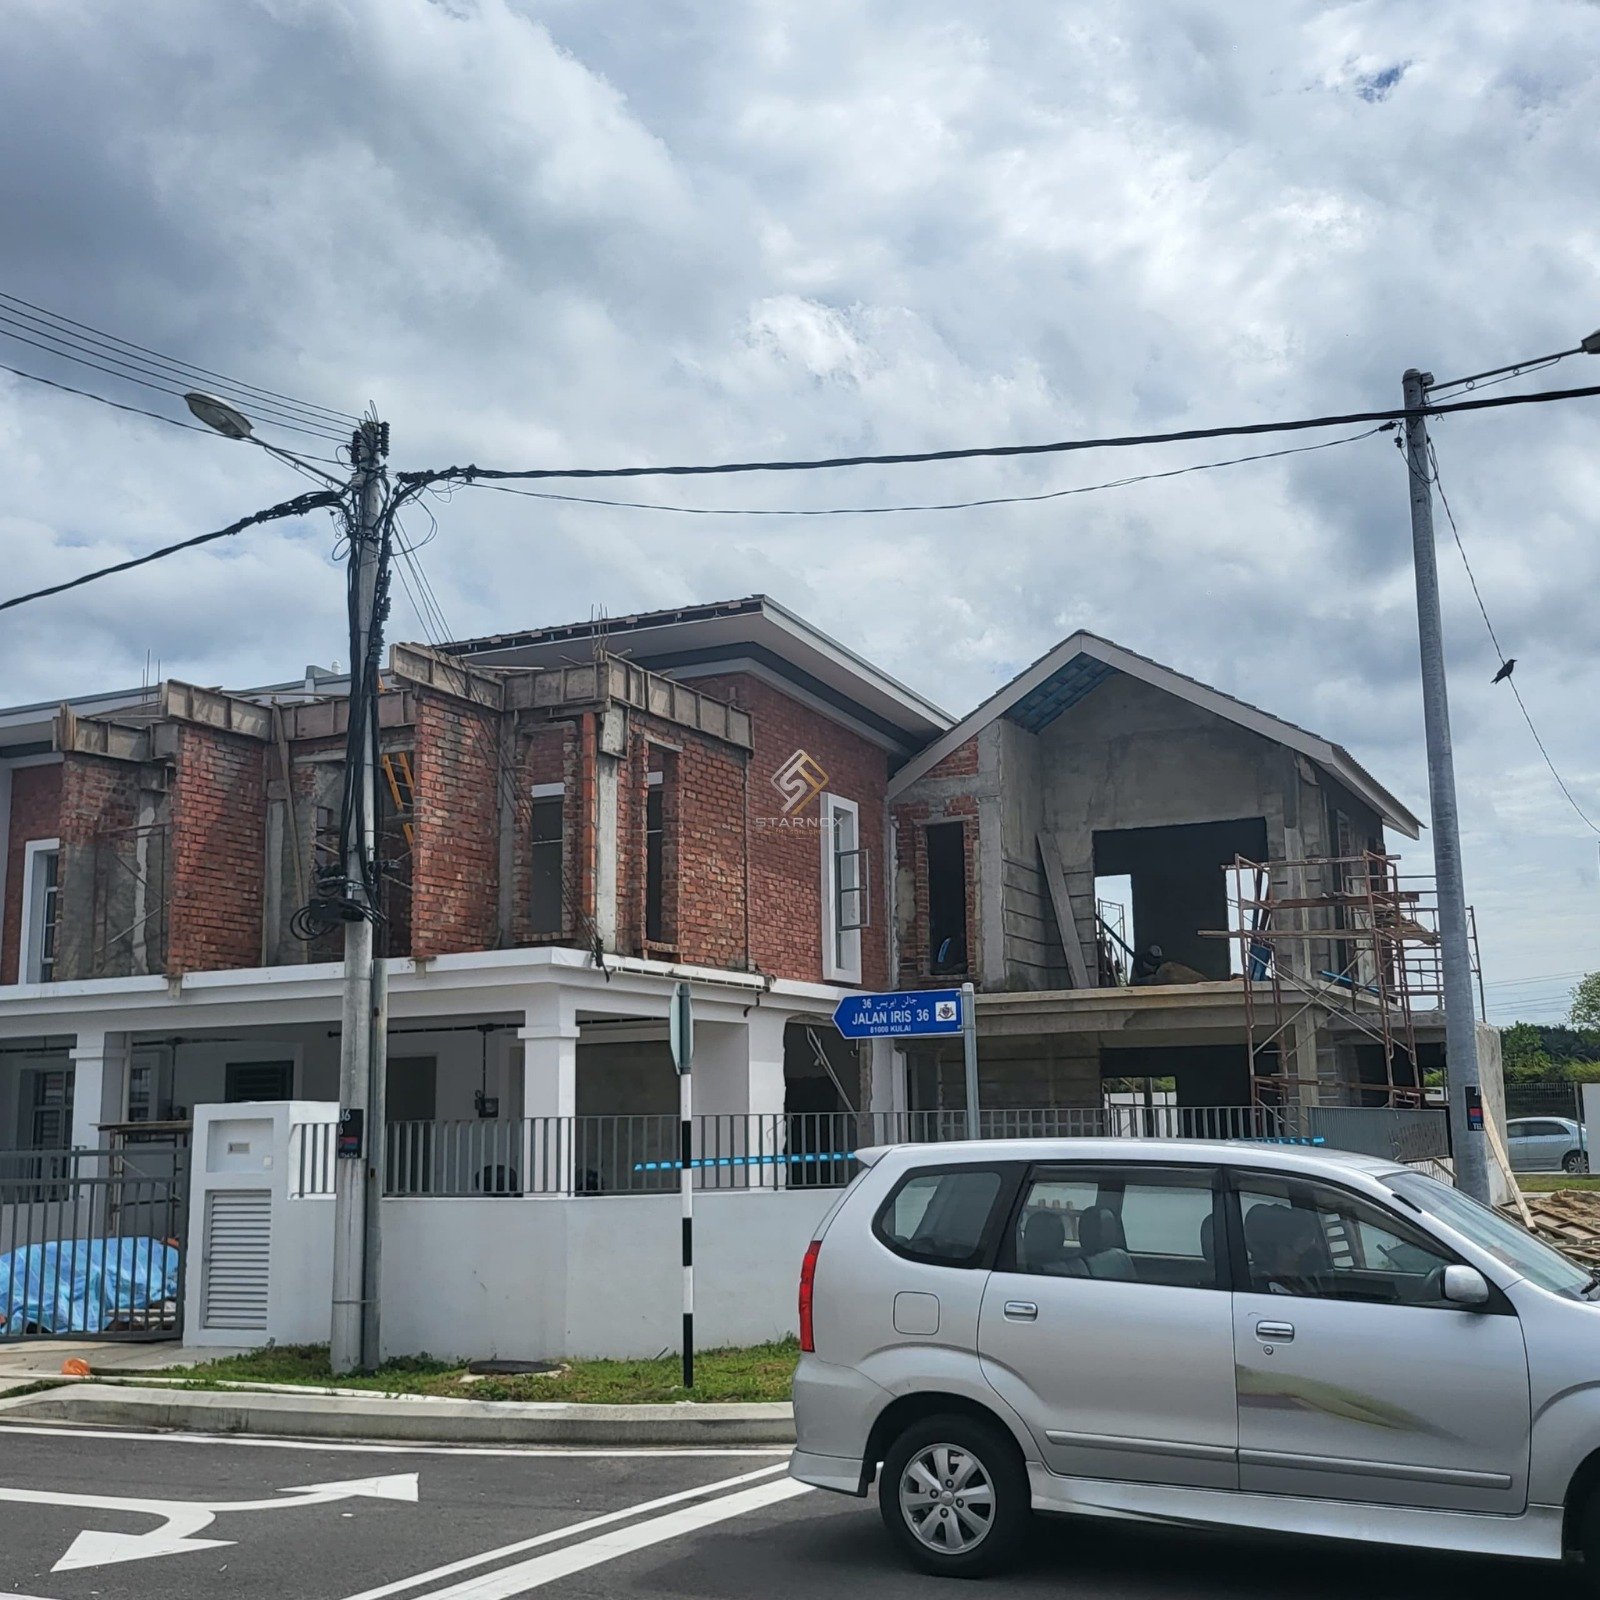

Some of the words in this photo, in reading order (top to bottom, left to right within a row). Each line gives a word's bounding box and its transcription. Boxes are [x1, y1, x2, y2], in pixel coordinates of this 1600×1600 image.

[862, 998, 872, 1009] 36
[852, 1011, 887, 1025] JALAN
[890, 1010, 912, 1023] IRIS
[916, 1009, 929, 1021] 36
